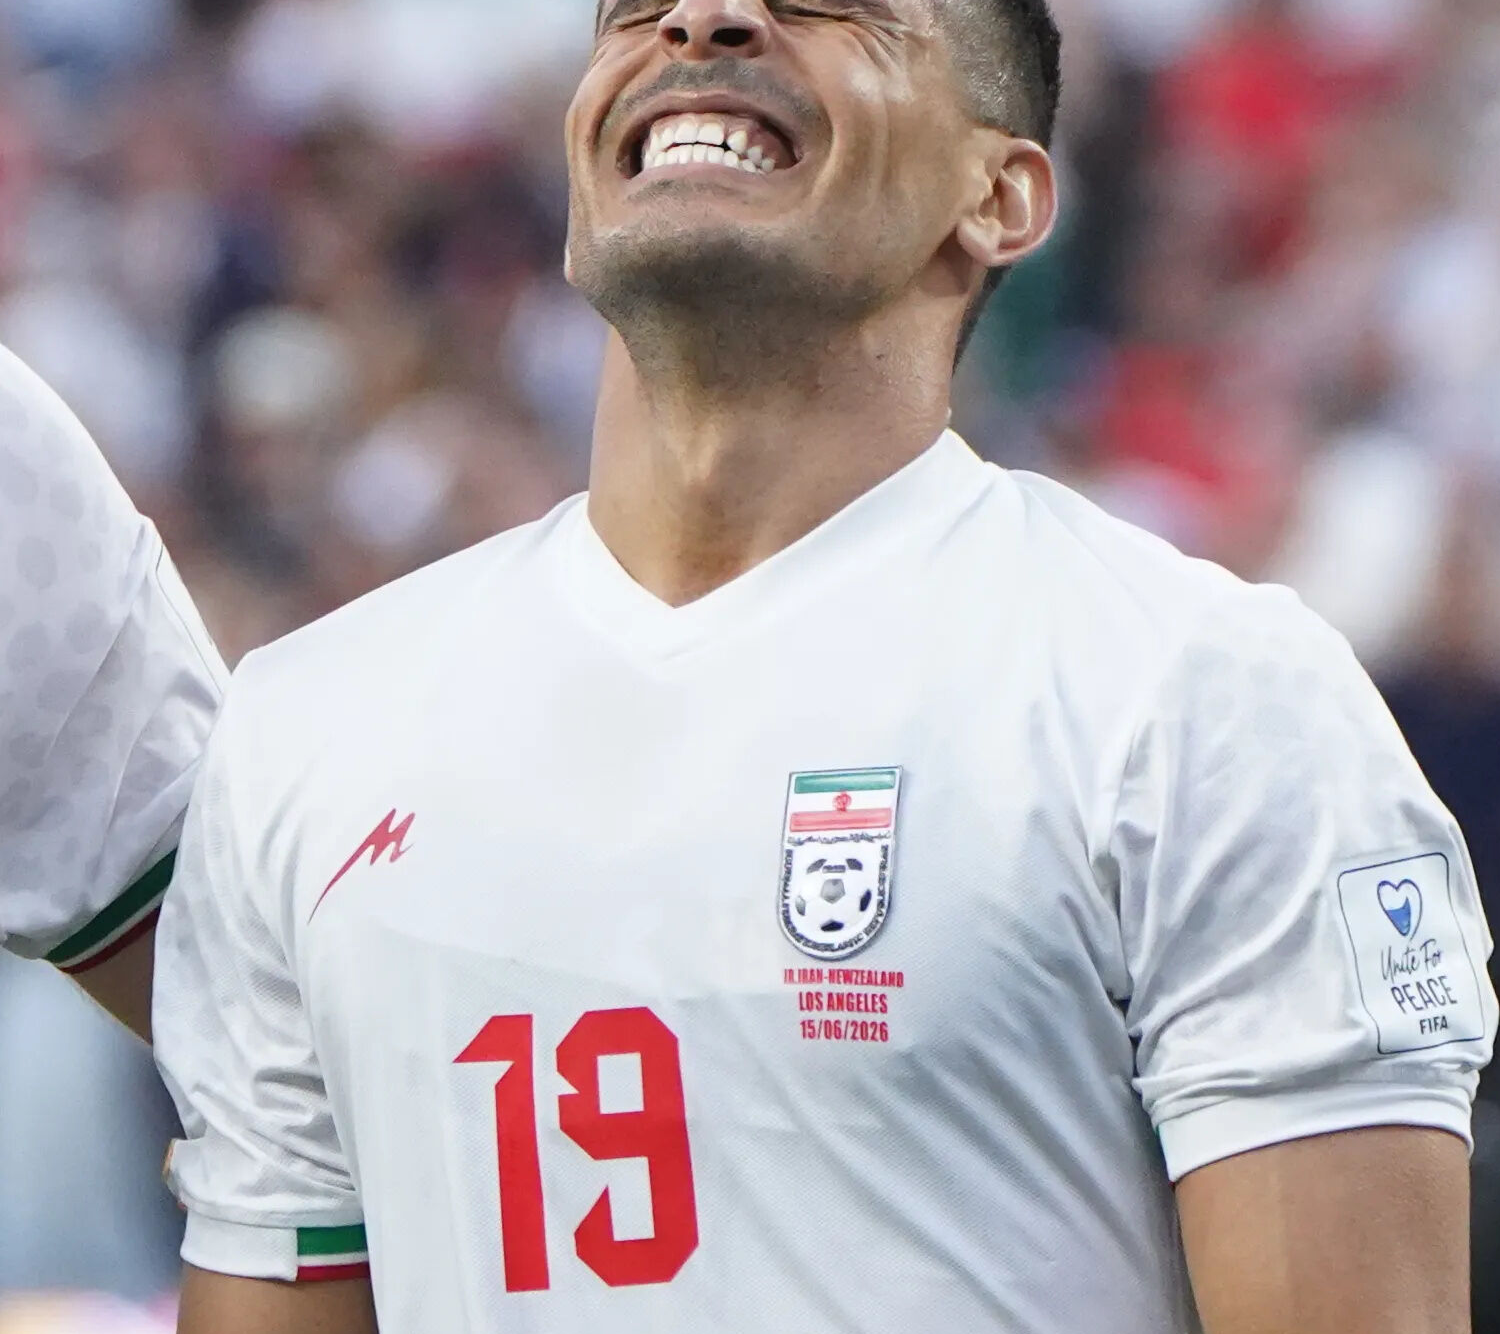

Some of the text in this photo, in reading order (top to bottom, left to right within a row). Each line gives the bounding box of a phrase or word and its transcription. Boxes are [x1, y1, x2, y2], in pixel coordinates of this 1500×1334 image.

[1381, 938, 1443, 983] Unite For
[798, 991, 888, 1014] LOS ANGELES
[1390, 975, 1458, 1014] PEACE
[800, 1019, 889, 1042] 15/06/2026
[1419, 1016, 1449, 1035] FIFA
[452, 1006, 699, 1293] 19
